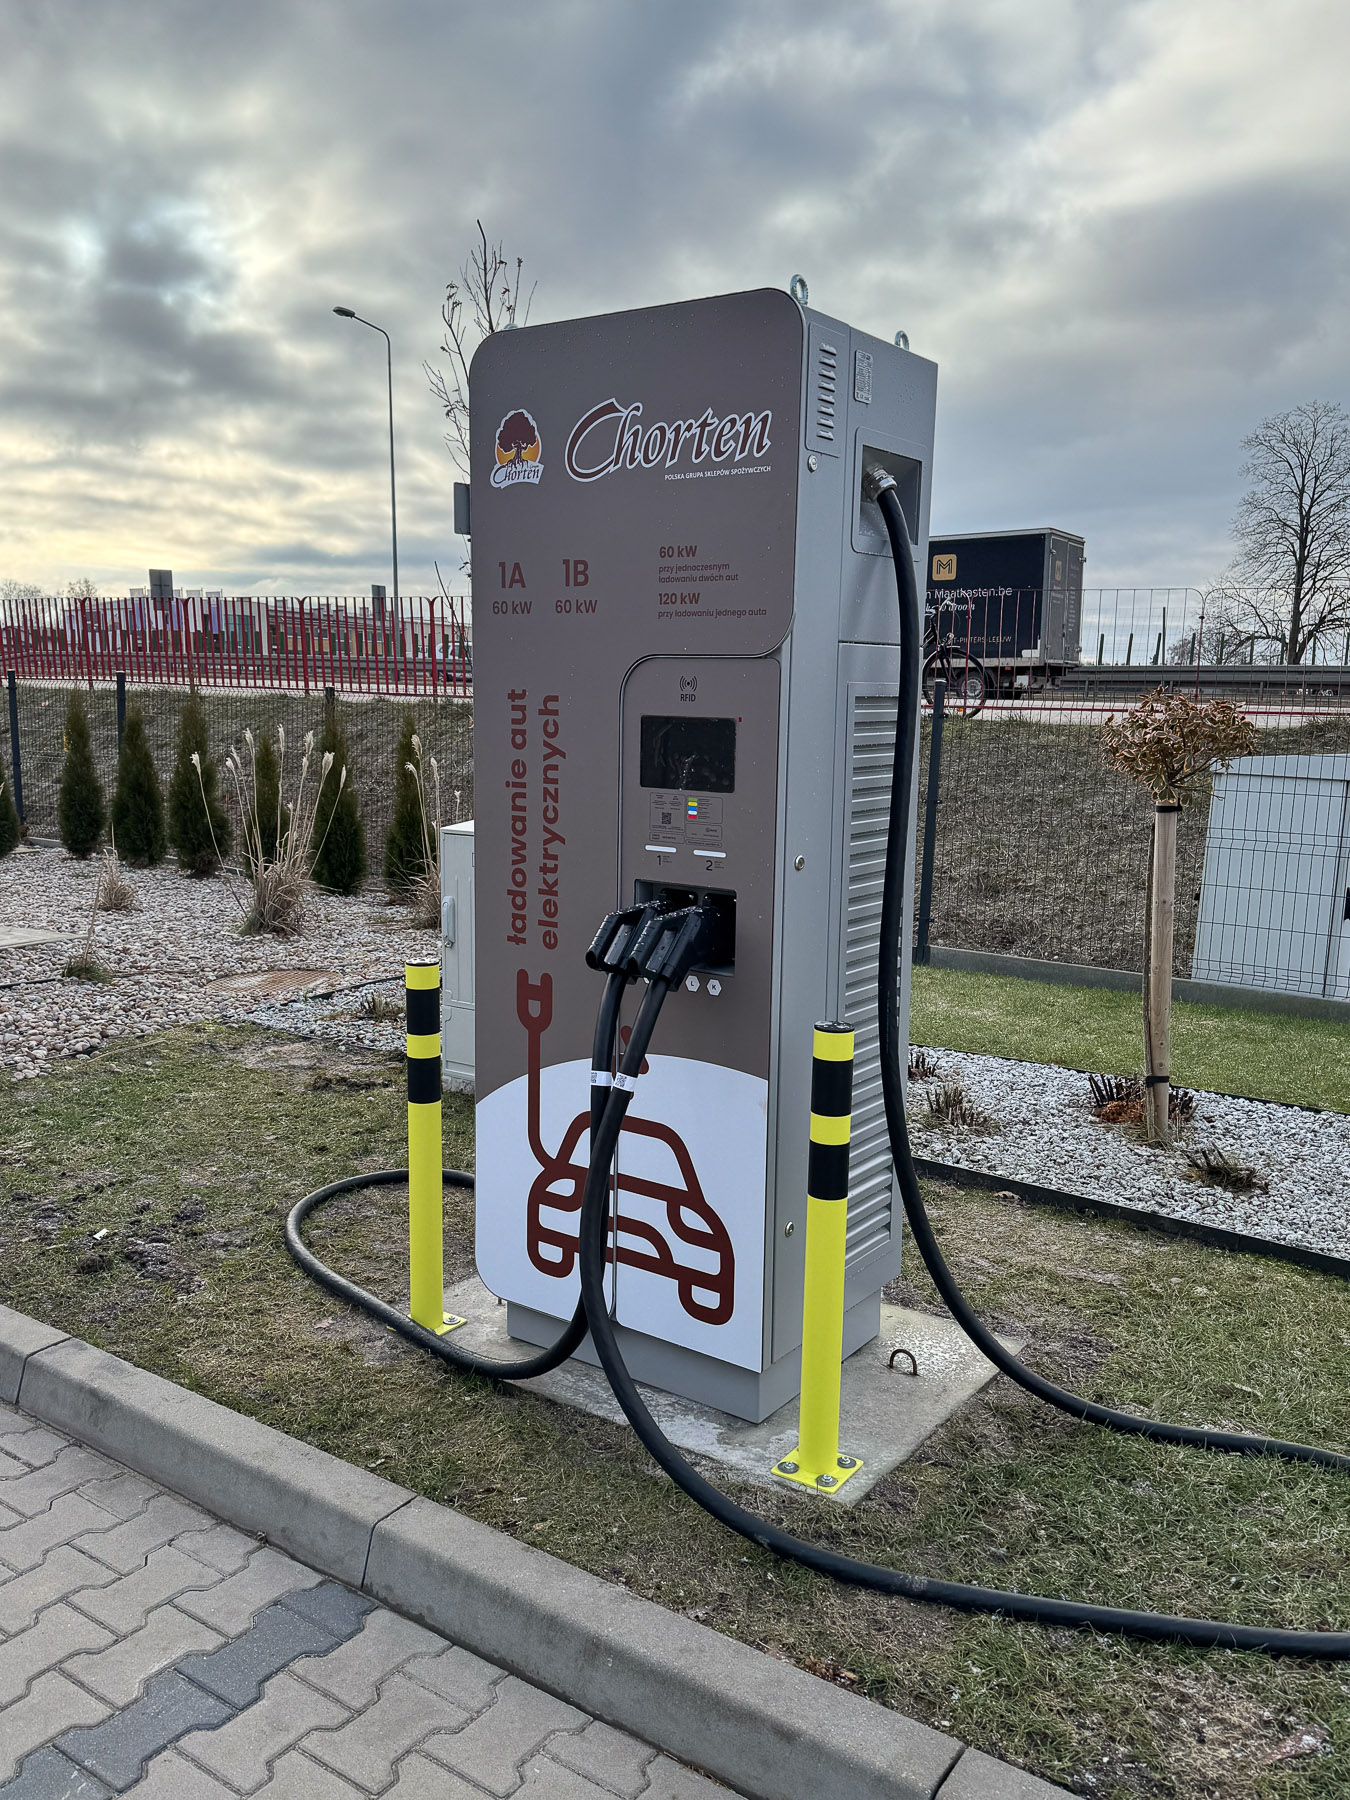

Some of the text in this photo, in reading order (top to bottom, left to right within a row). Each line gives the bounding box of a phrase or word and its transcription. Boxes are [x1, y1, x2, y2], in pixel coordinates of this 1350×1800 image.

[564, 398, 772, 482] Chorten
[493, 463, 540, 484] Chorten
[685, 471, 704, 479] GRUPA
[704, 469, 730, 477] SKLEPÓW
[730, 465, 772, 475] SPOŻYWCZYCH
[659, 545, 698, 558] 60 kW
[562, 559, 589, 587] 1B
[658, 563, 730, 575] przy jednoczesnym
[936, 559, 953, 575] M
[498, 561, 526, 589] 1A
[698, 573, 724, 582] dwóch
[725, 573, 739, 581] aut
[658, 592, 700, 605] 120 kW
[935, 586, 1013, 599] Maatkasten.be
[492, 600, 533, 615] 60 kW
[555, 599, 598, 614] 60 kW
[657, 611, 673, 619] przy
[715, 608, 747, 618] jednego
[748, 608, 767, 616] auta
[680, 693, 697, 702] RFID
[505, 688, 527, 945] ładowanie aut
[537, 694, 566, 950] elektrycznych
[657, 855, 661, 866] 1
[705, 860, 713, 871] 2
